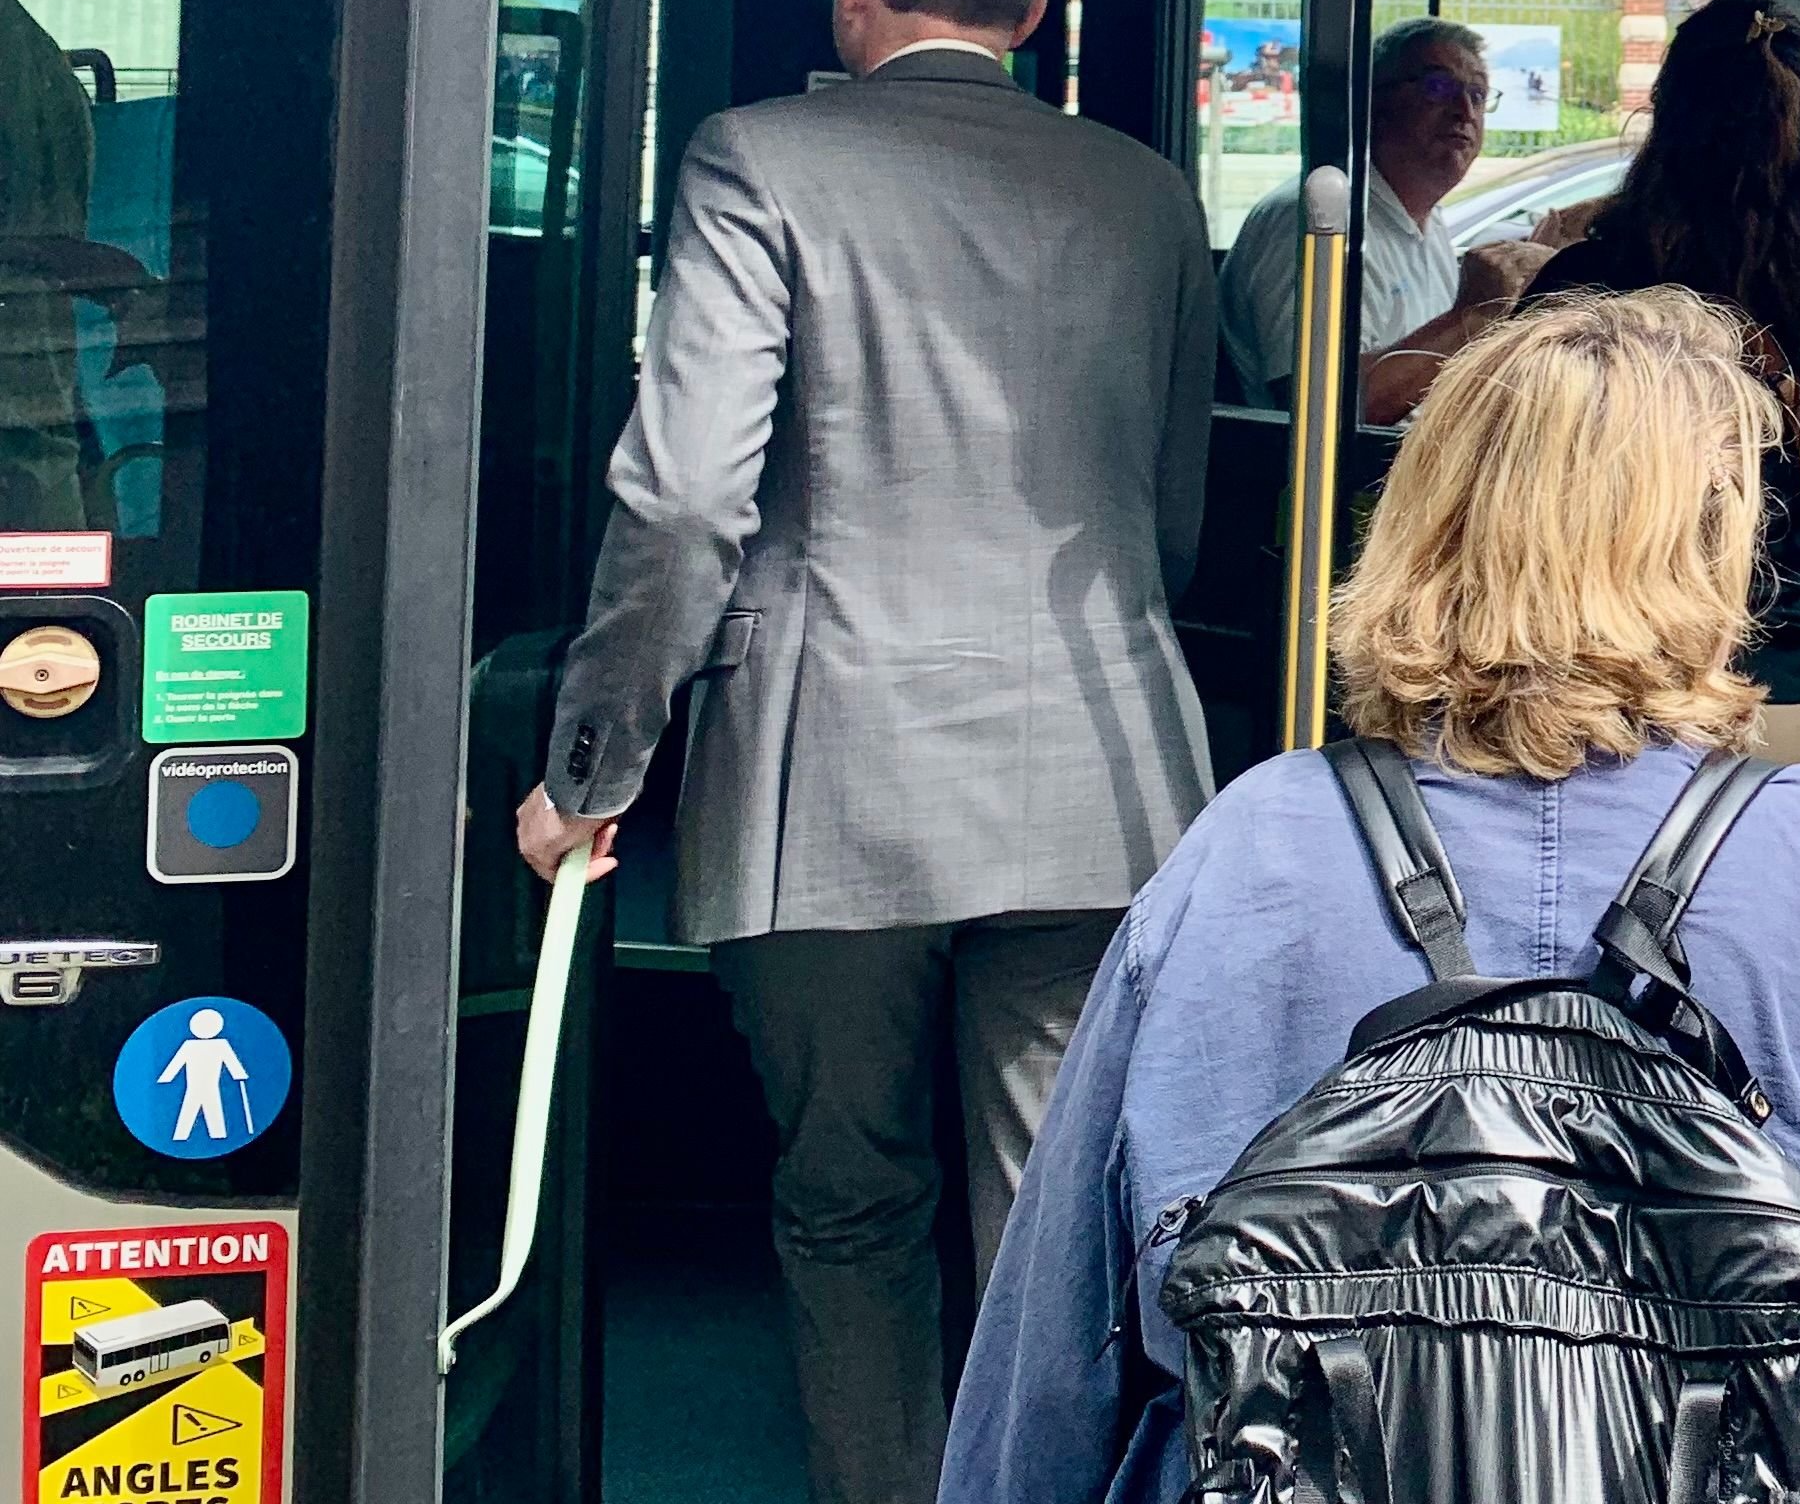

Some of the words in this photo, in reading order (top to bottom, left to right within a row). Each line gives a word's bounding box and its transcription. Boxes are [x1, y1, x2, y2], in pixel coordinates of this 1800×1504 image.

[171, 613, 254, 629] ROBINET
[257, 612, 284, 627] DE
[181, 632, 272, 648] SECOURS
[161, 760, 288, 779] vidéoprotection
[12, 971, 62, 999] 6
[41, 1233, 269, 1274] ATTENTION
[60, 1457, 240, 1499] ANGLES
